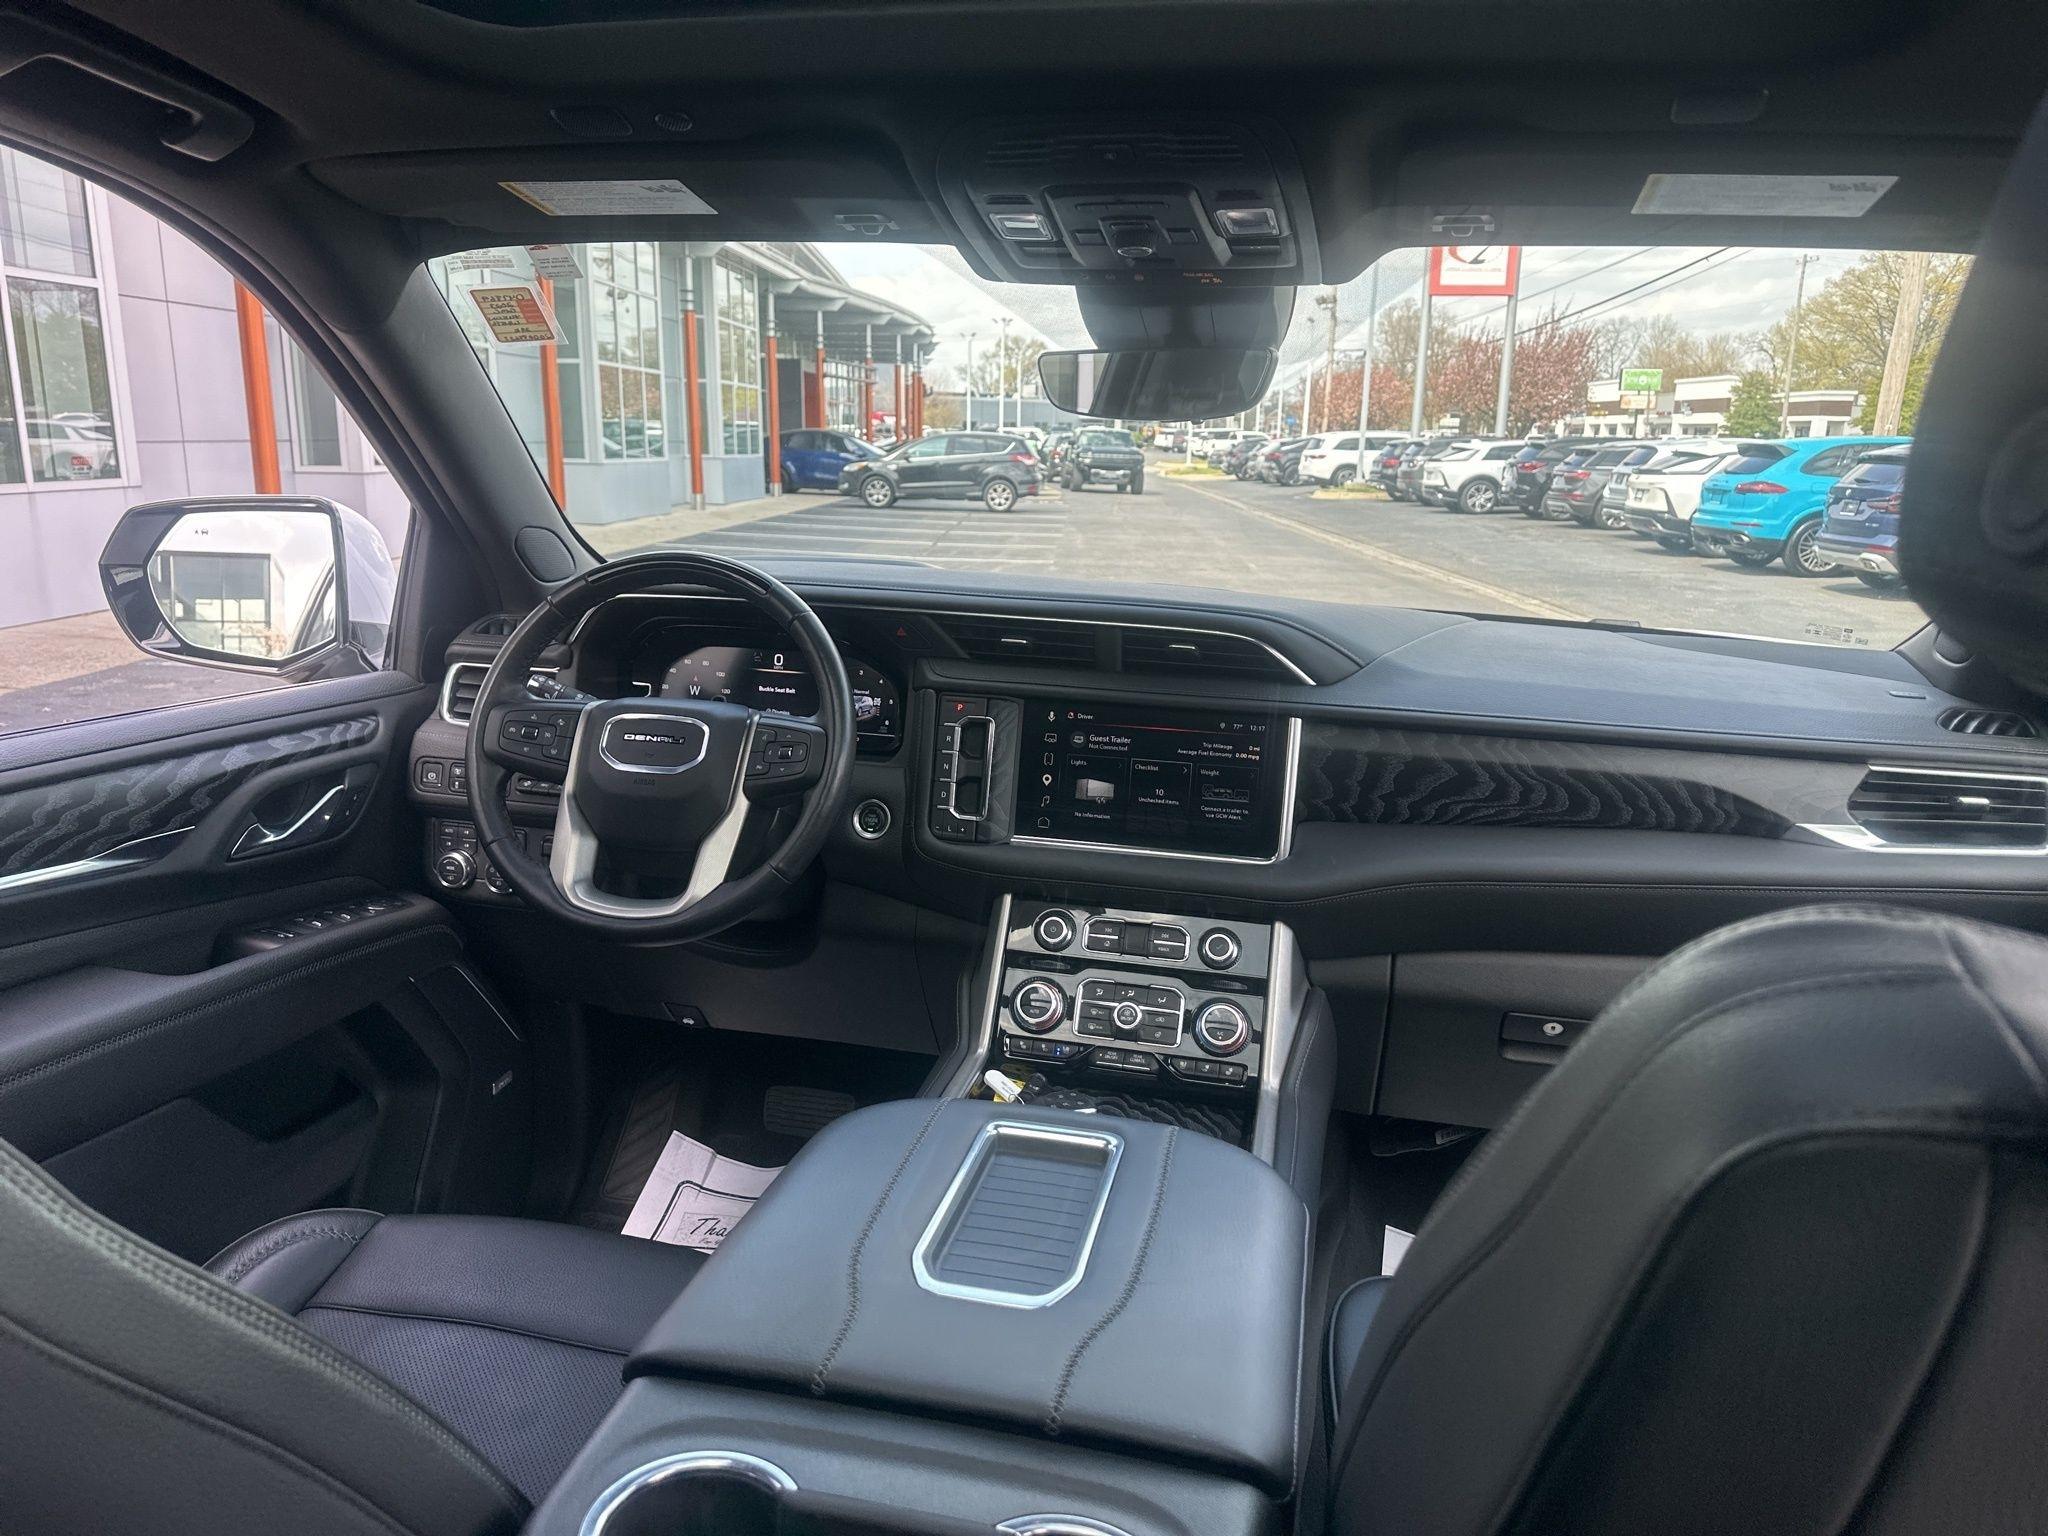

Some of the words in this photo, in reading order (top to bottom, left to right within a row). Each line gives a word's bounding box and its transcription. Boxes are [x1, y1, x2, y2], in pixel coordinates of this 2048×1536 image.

[774, 653, 784, 666] 0
[689, 685, 701, 696] W
[758, 685, 774, 693] Buckle
[957, 703, 964, 711] P
[623, 733, 686, 745] DENALI
[1089, 734, 1110, 743] Guest
[1111, 735, 1132, 744] Trailer
[1099, 744, 1128, 752] Connected
[1213, 743, 1233, 751] Mileage
[1177, 748, 1198, 756] Average
[1209, 750, 1233, 759] Economy
[1070, 759, 1087, 767] Lights
[1134, 763, 1159, 772] Checklist
[1200, 768, 1220, 777] Weight
[1155, 788, 1165, 797] 10
[1200, 805, 1222, 813] Connect
